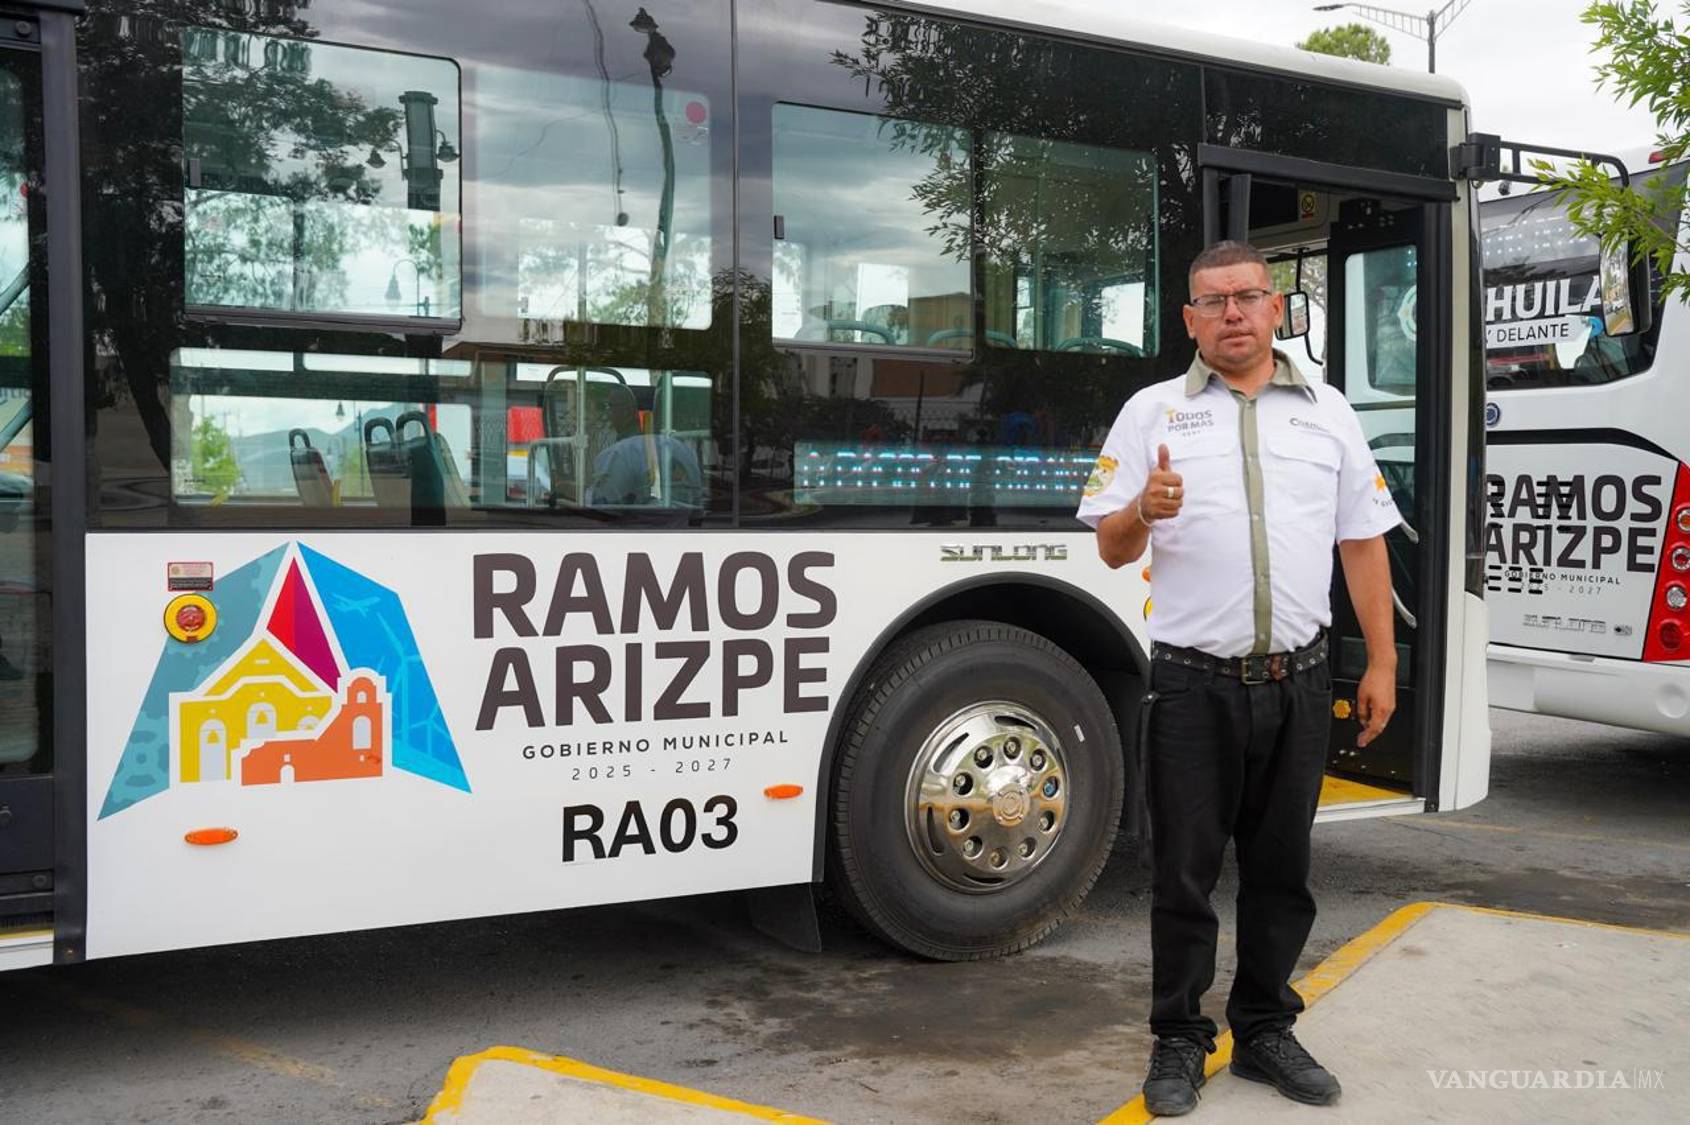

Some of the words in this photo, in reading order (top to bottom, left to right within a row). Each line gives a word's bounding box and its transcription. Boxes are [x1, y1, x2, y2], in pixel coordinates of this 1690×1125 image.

[1497, 323, 1569, 343] DELANTE
[1486, 474, 1663, 522] RAMOS
[939, 544, 1068, 562] SUNLONG
[1486, 522, 1658, 573] ARIZPE
[1560, 573, 1621, 585] MUNICIPAL
[1569, 585, 1602, 595] 2027
[473, 551, 838, 639] RAMOS
[475, 637, 831, 731] ARIZPE
[522, 738, 651, 760] GOBIERNO
[663, 730, 789, 751] MUNICIPAL
[571, 764, 633, 781] 2025
[675, 757, 732, 774] 2027
[562, 794, 739, 863] RA03
